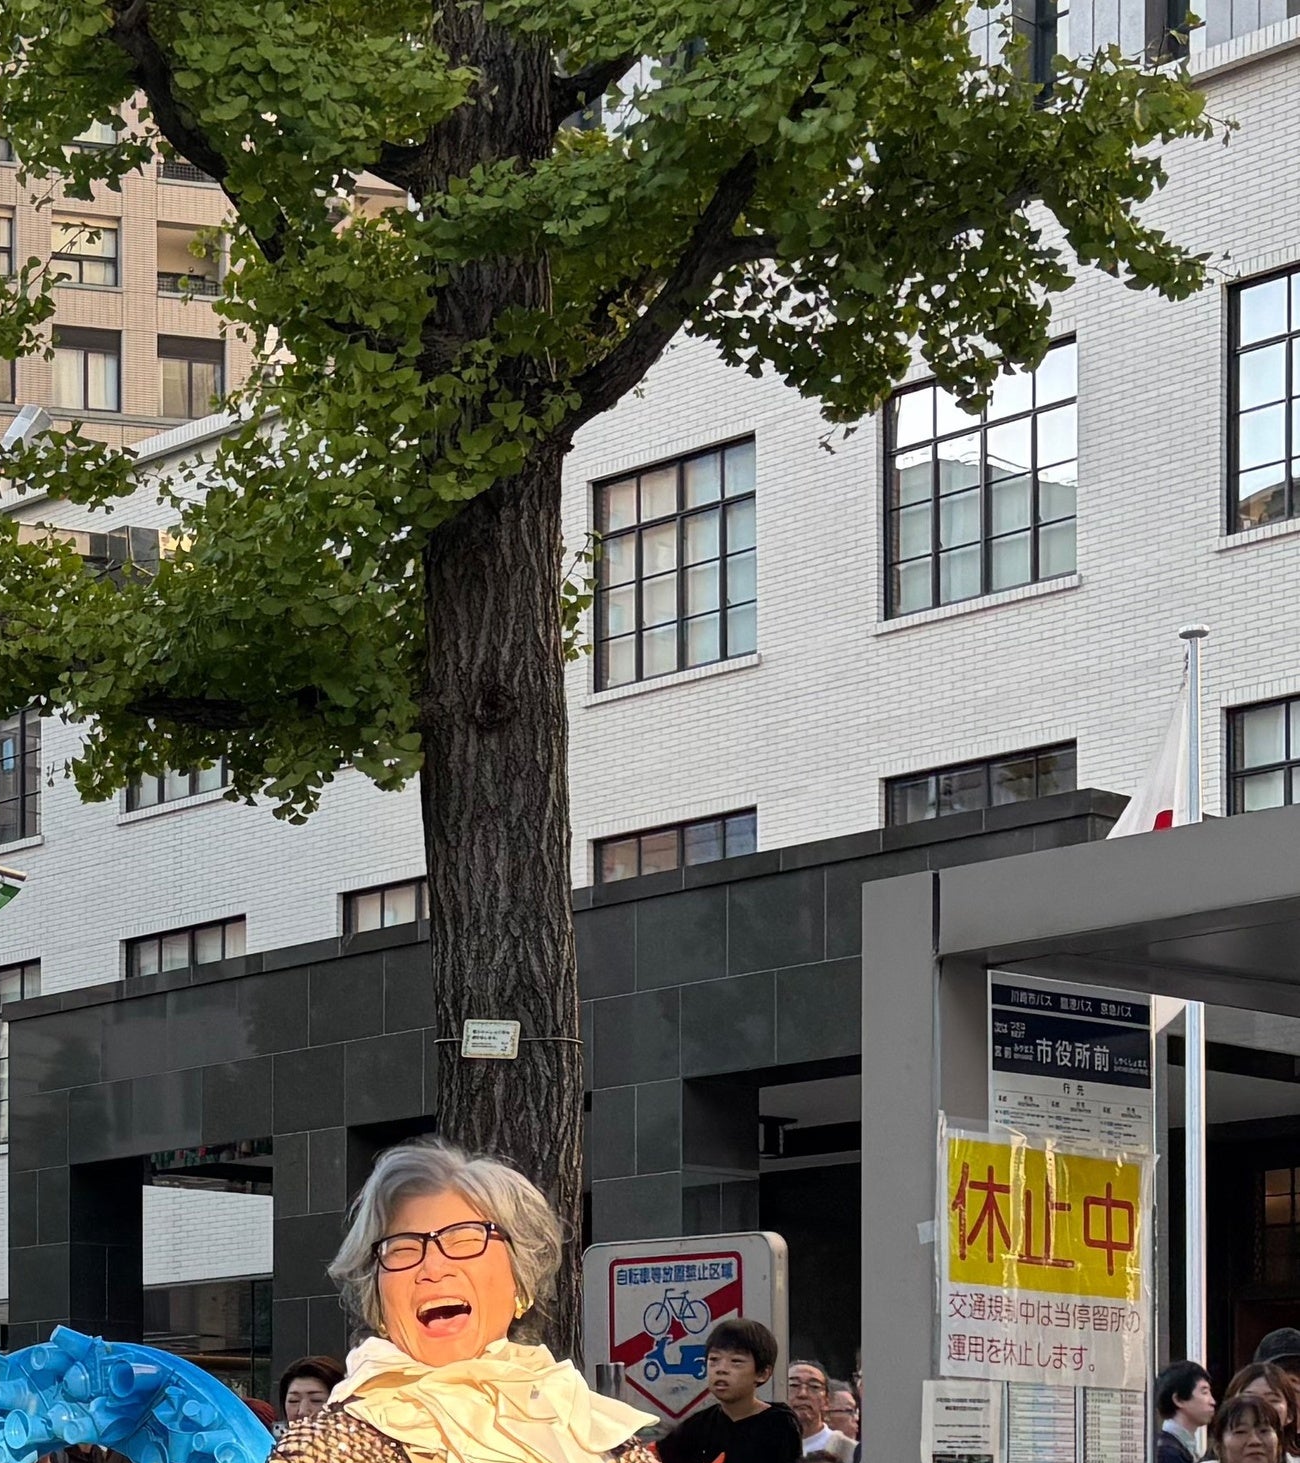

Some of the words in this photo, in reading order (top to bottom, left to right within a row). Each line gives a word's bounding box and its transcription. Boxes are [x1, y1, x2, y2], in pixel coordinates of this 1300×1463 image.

[1011, 989, 1052, 1006] 川崎市バス
[1101, 1002, 1132, 1018] 京急バス
[1036, 1037, 1110, 1072] 市役所前
[952, 1161, 1135, 1276] 休止中
[948, 1334, 1098, 1373] 運用を休止します。
